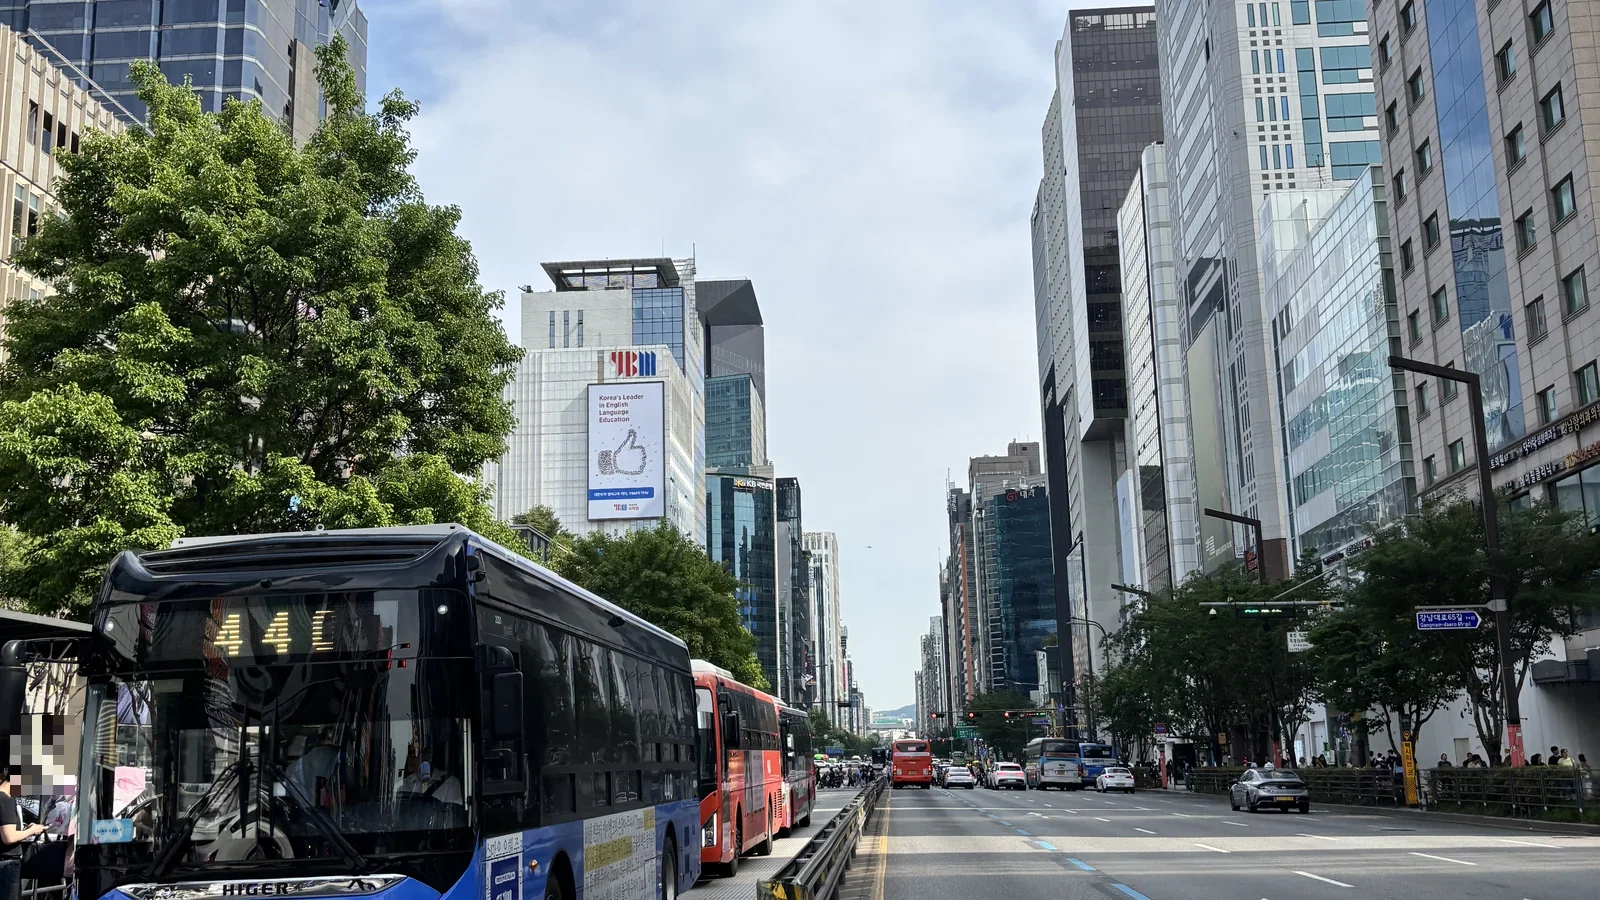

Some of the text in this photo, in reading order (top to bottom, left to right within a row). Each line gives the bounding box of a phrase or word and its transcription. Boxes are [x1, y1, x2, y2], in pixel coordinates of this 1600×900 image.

[611, 350, 657, 377] YBM
[746, 480, 757, 488] KB
[1419, 613, 1463, 622] 강남대로65길
[222, 882, 289, 896] HIGER
